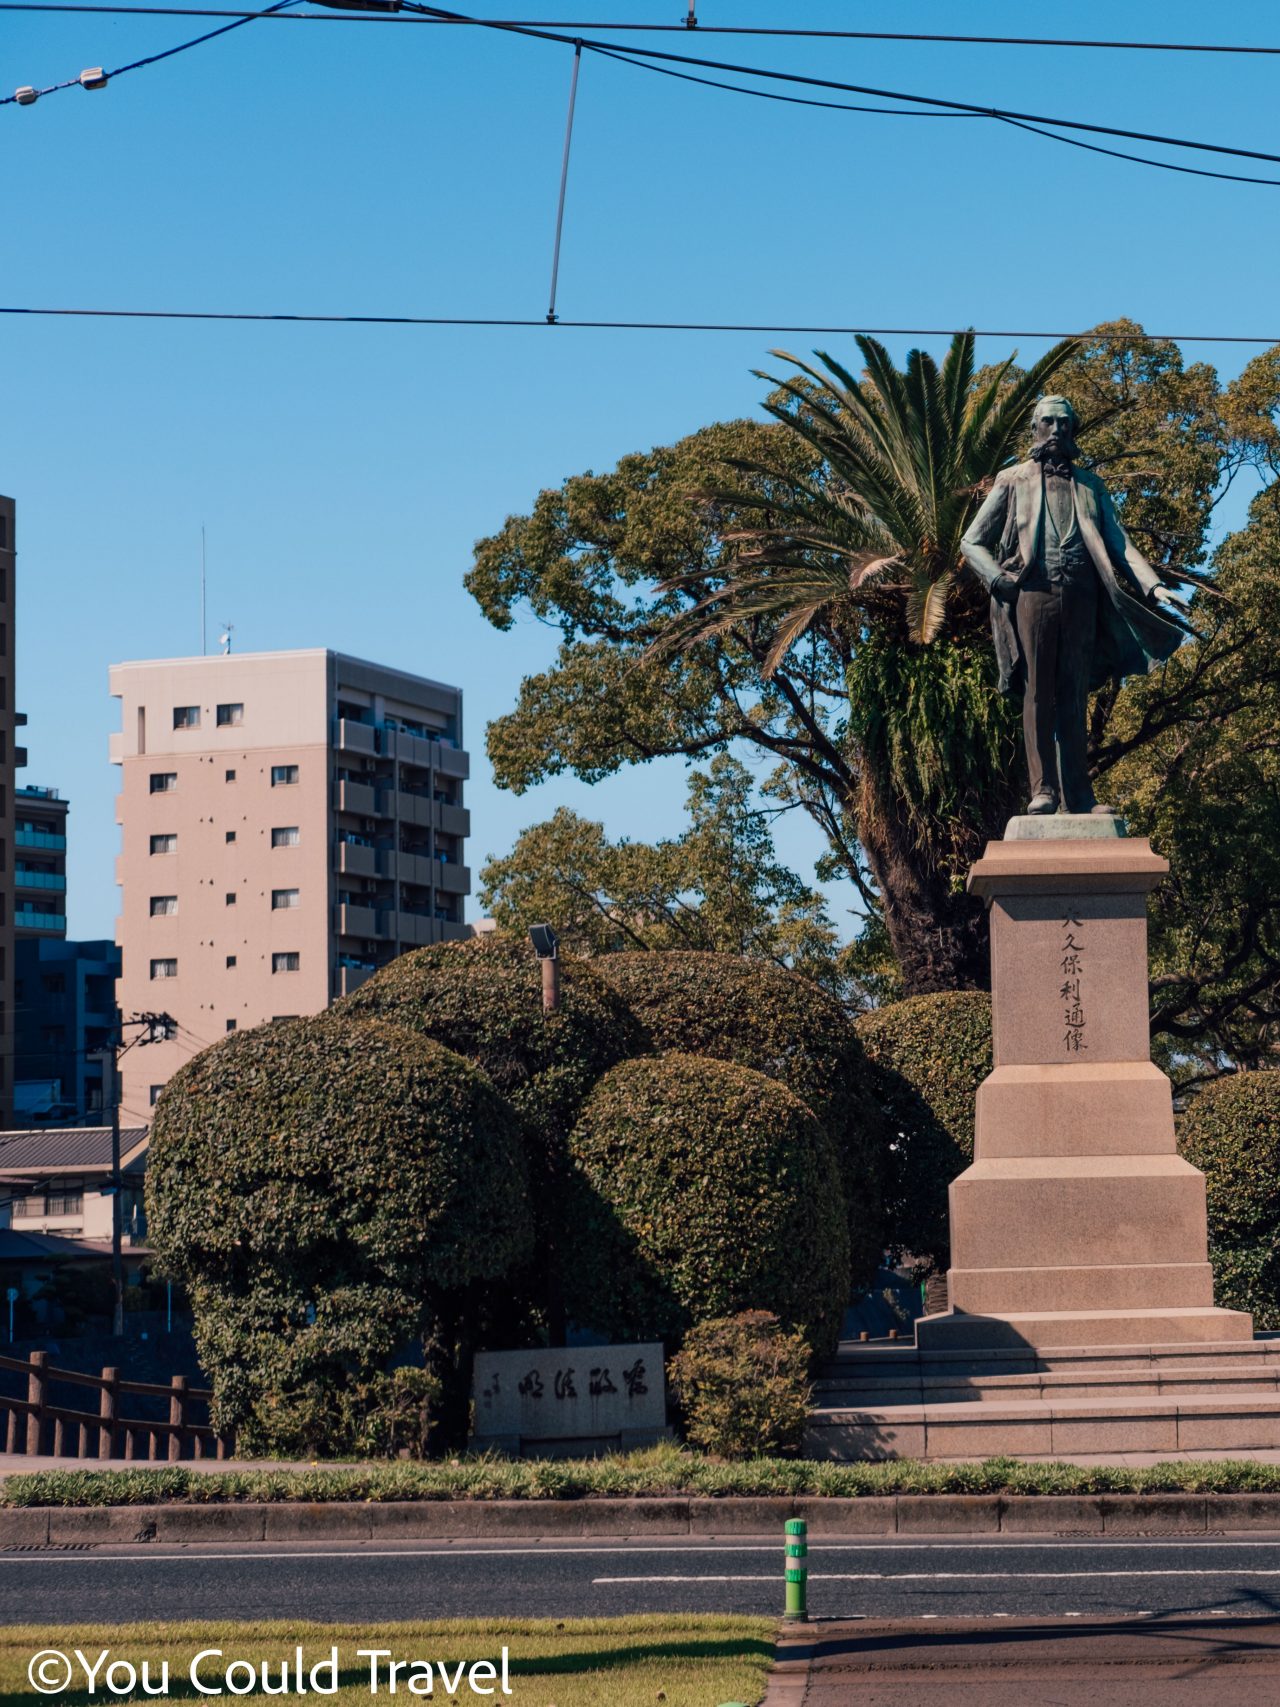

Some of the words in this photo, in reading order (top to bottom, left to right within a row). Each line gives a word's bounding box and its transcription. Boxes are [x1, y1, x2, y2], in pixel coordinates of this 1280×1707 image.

[1060, 907, 1088, 1051] 大久保利通像
